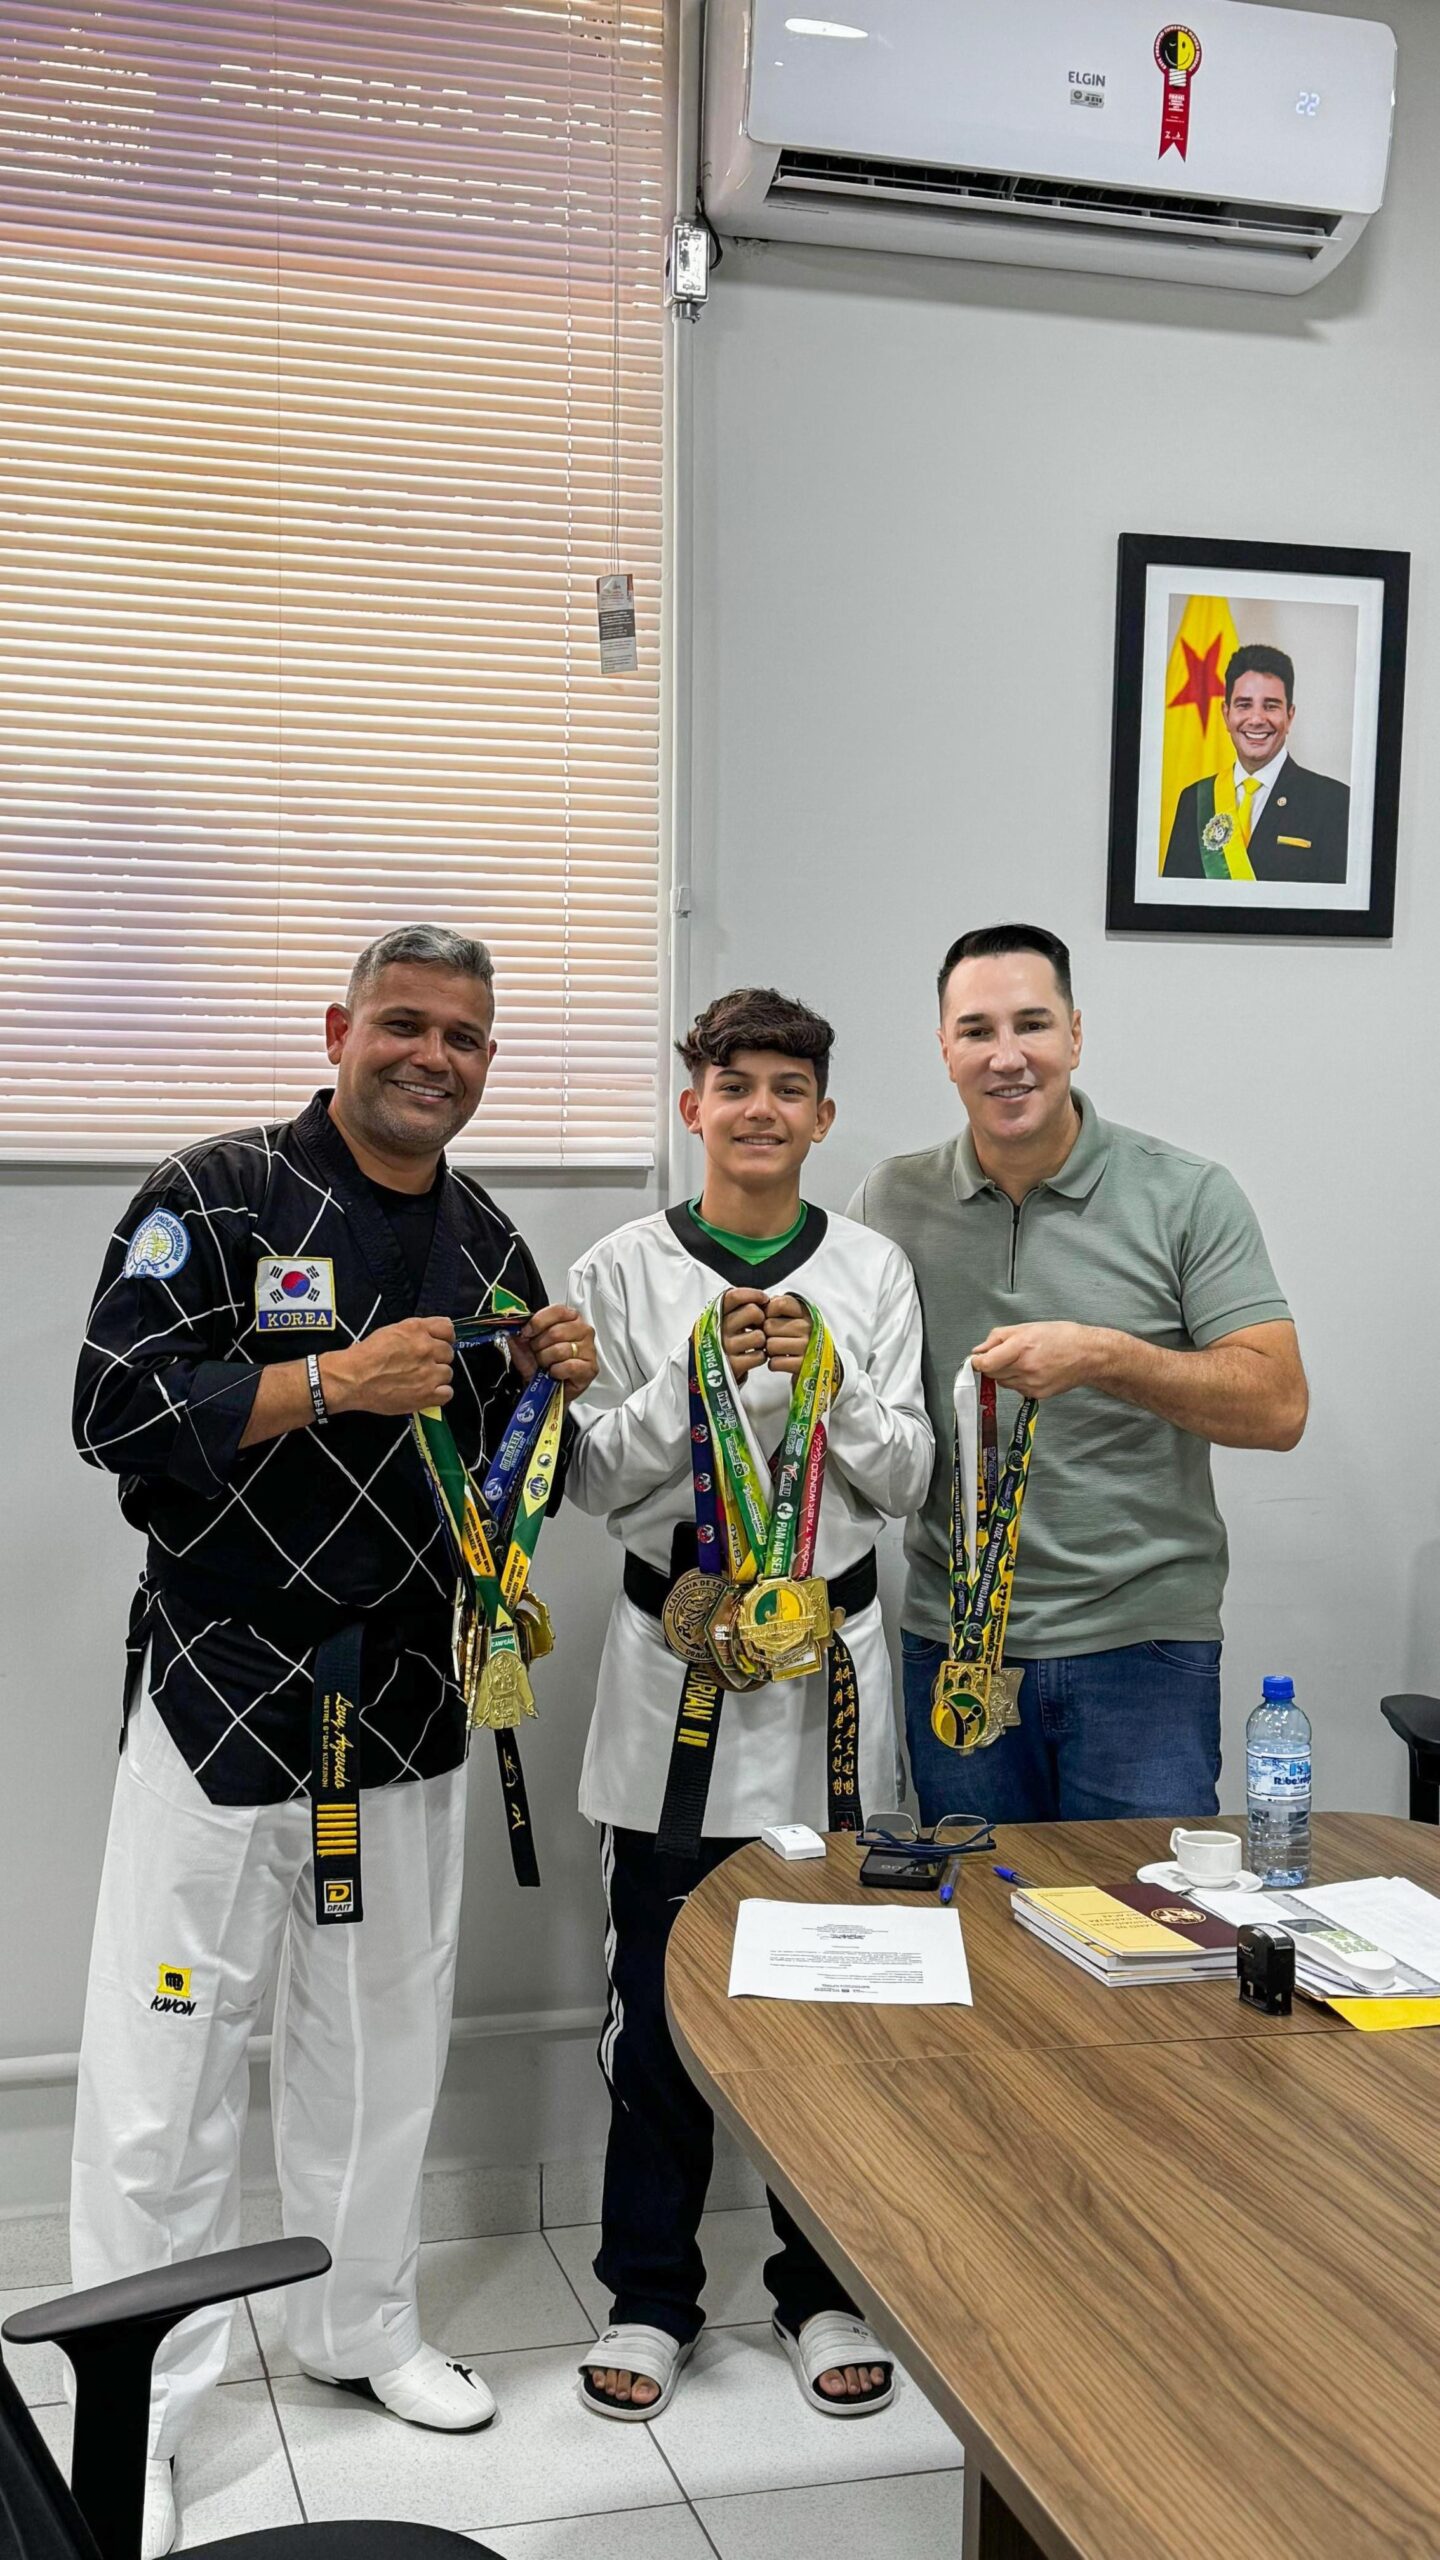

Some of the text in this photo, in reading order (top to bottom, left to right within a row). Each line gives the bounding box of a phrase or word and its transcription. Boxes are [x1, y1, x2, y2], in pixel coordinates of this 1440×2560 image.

[1068, 71, 1106, 87] ELGIN
[1296, 92, 1320, 116] 22
[267, 1311, 329, 1327] KOREA
[705, 1347, 718, 1368] PAN
[806, 1463, 819, 1532] TAEKWONDO
[776, 1521, 788, 1538] PAN
[473, 1530, 487, 1559] TAEKWONDO
[482, 1559, 491, 1573] OPEN
[774, 1539, 785, 1555] AM
[504, 1550, 521, 1594] TAEKWONDO OPEN
[974, 1523, 1004, 1617] CAMPEONATO ESTADUAL 2024
[668, 1581, 698, 1614] ACADEMIA
[150, 1994, 197, 2017] KWON
